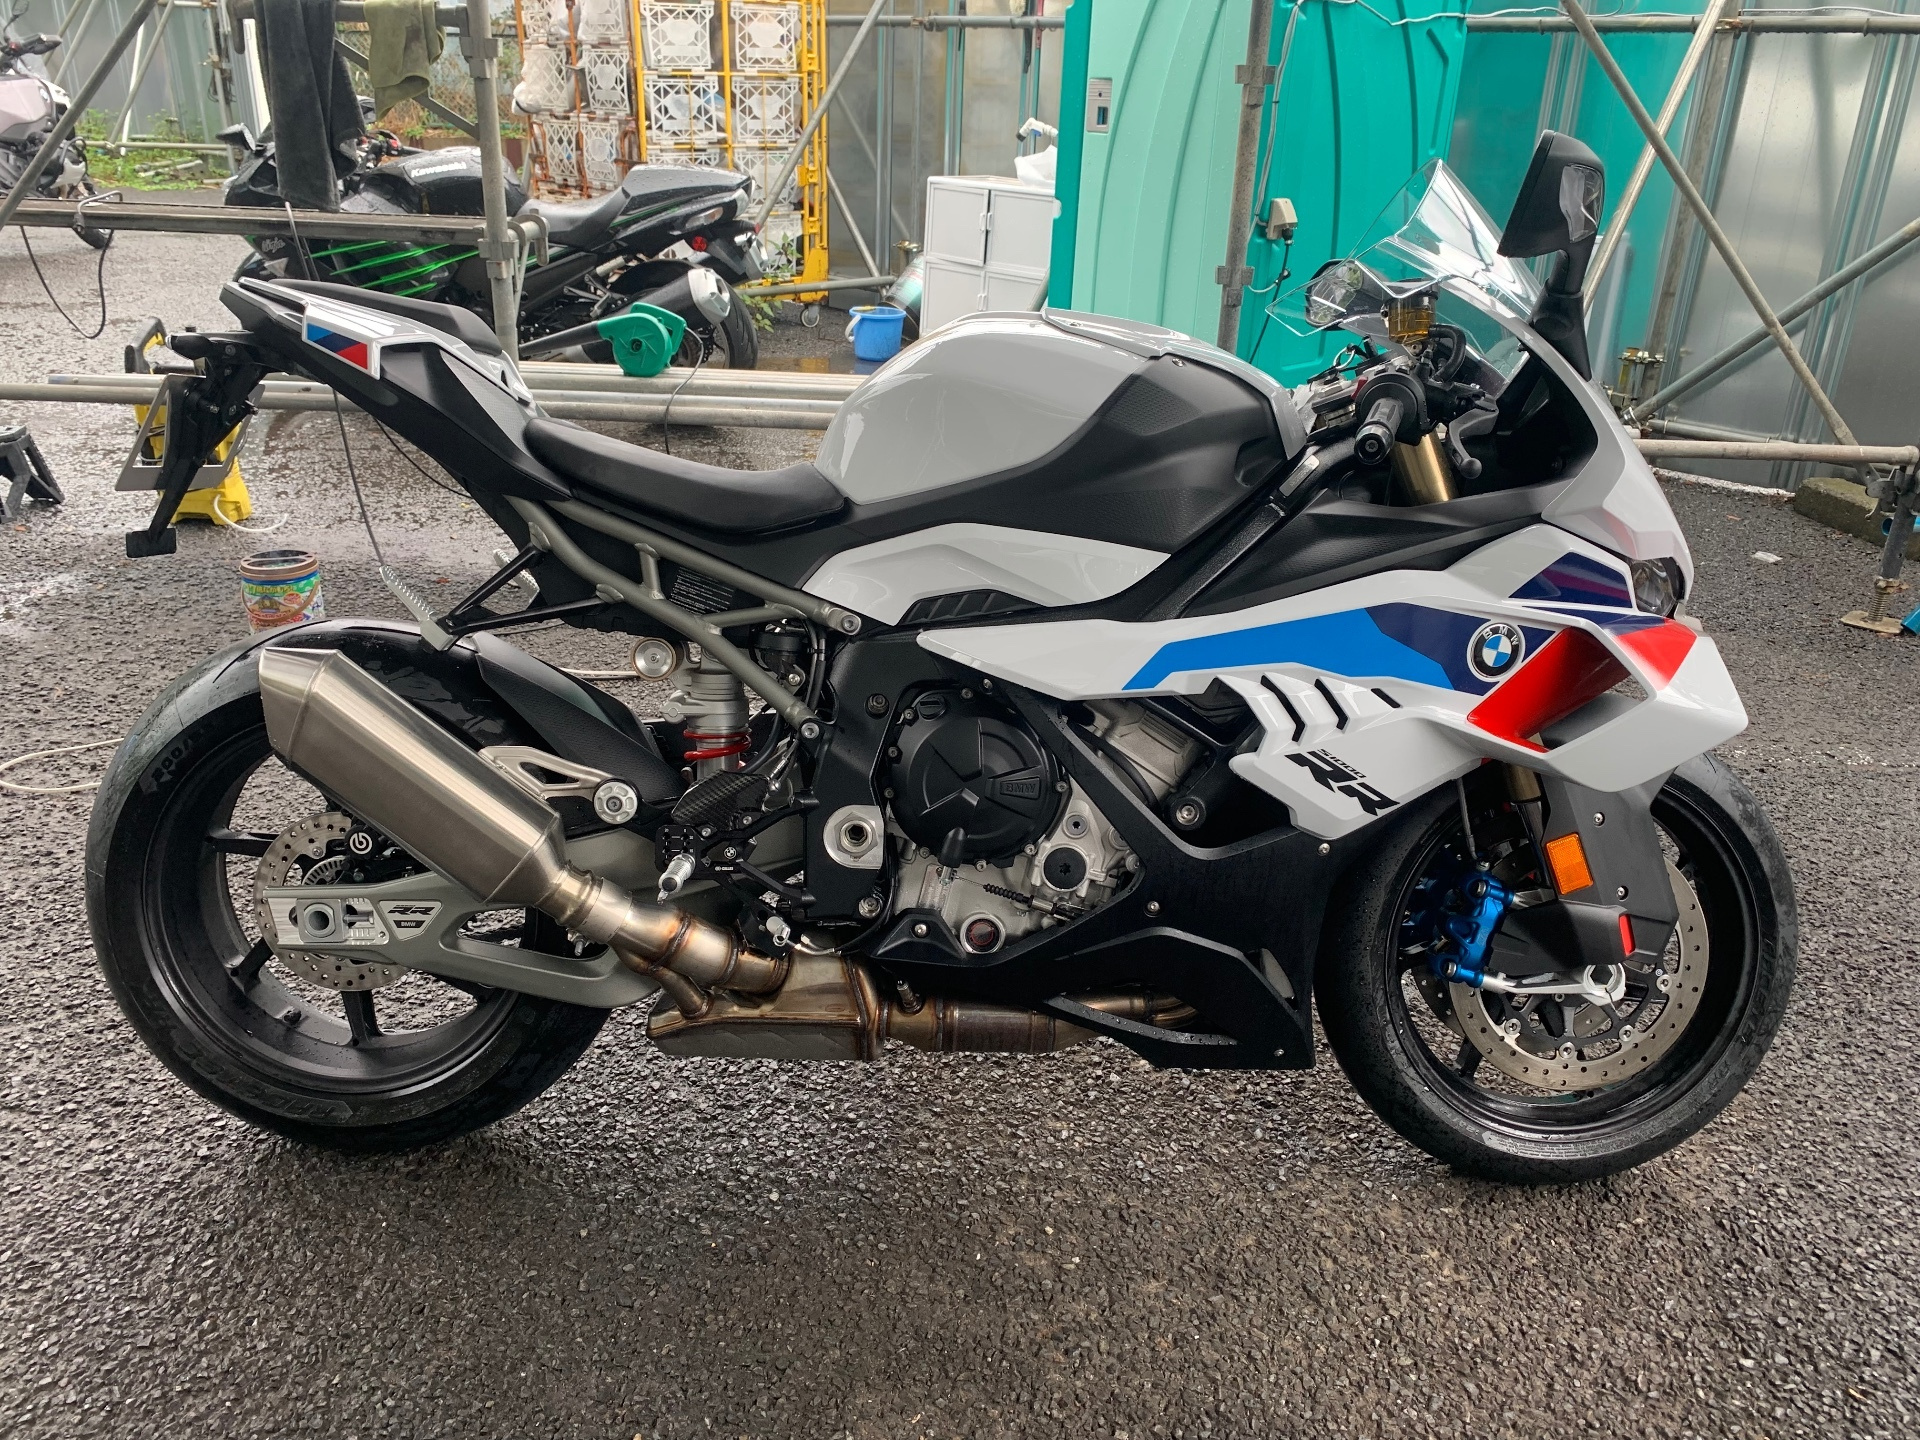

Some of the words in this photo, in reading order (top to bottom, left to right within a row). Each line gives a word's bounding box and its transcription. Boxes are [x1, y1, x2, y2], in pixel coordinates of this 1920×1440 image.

[1482, 625, 1520, 646] BMW
[1317, 748, 1367, 779] S1000
[1005, 782, 1036, 793] BMW
[1284, 752, 1401, 817] RR
[387, 906, 436, 916] RR
